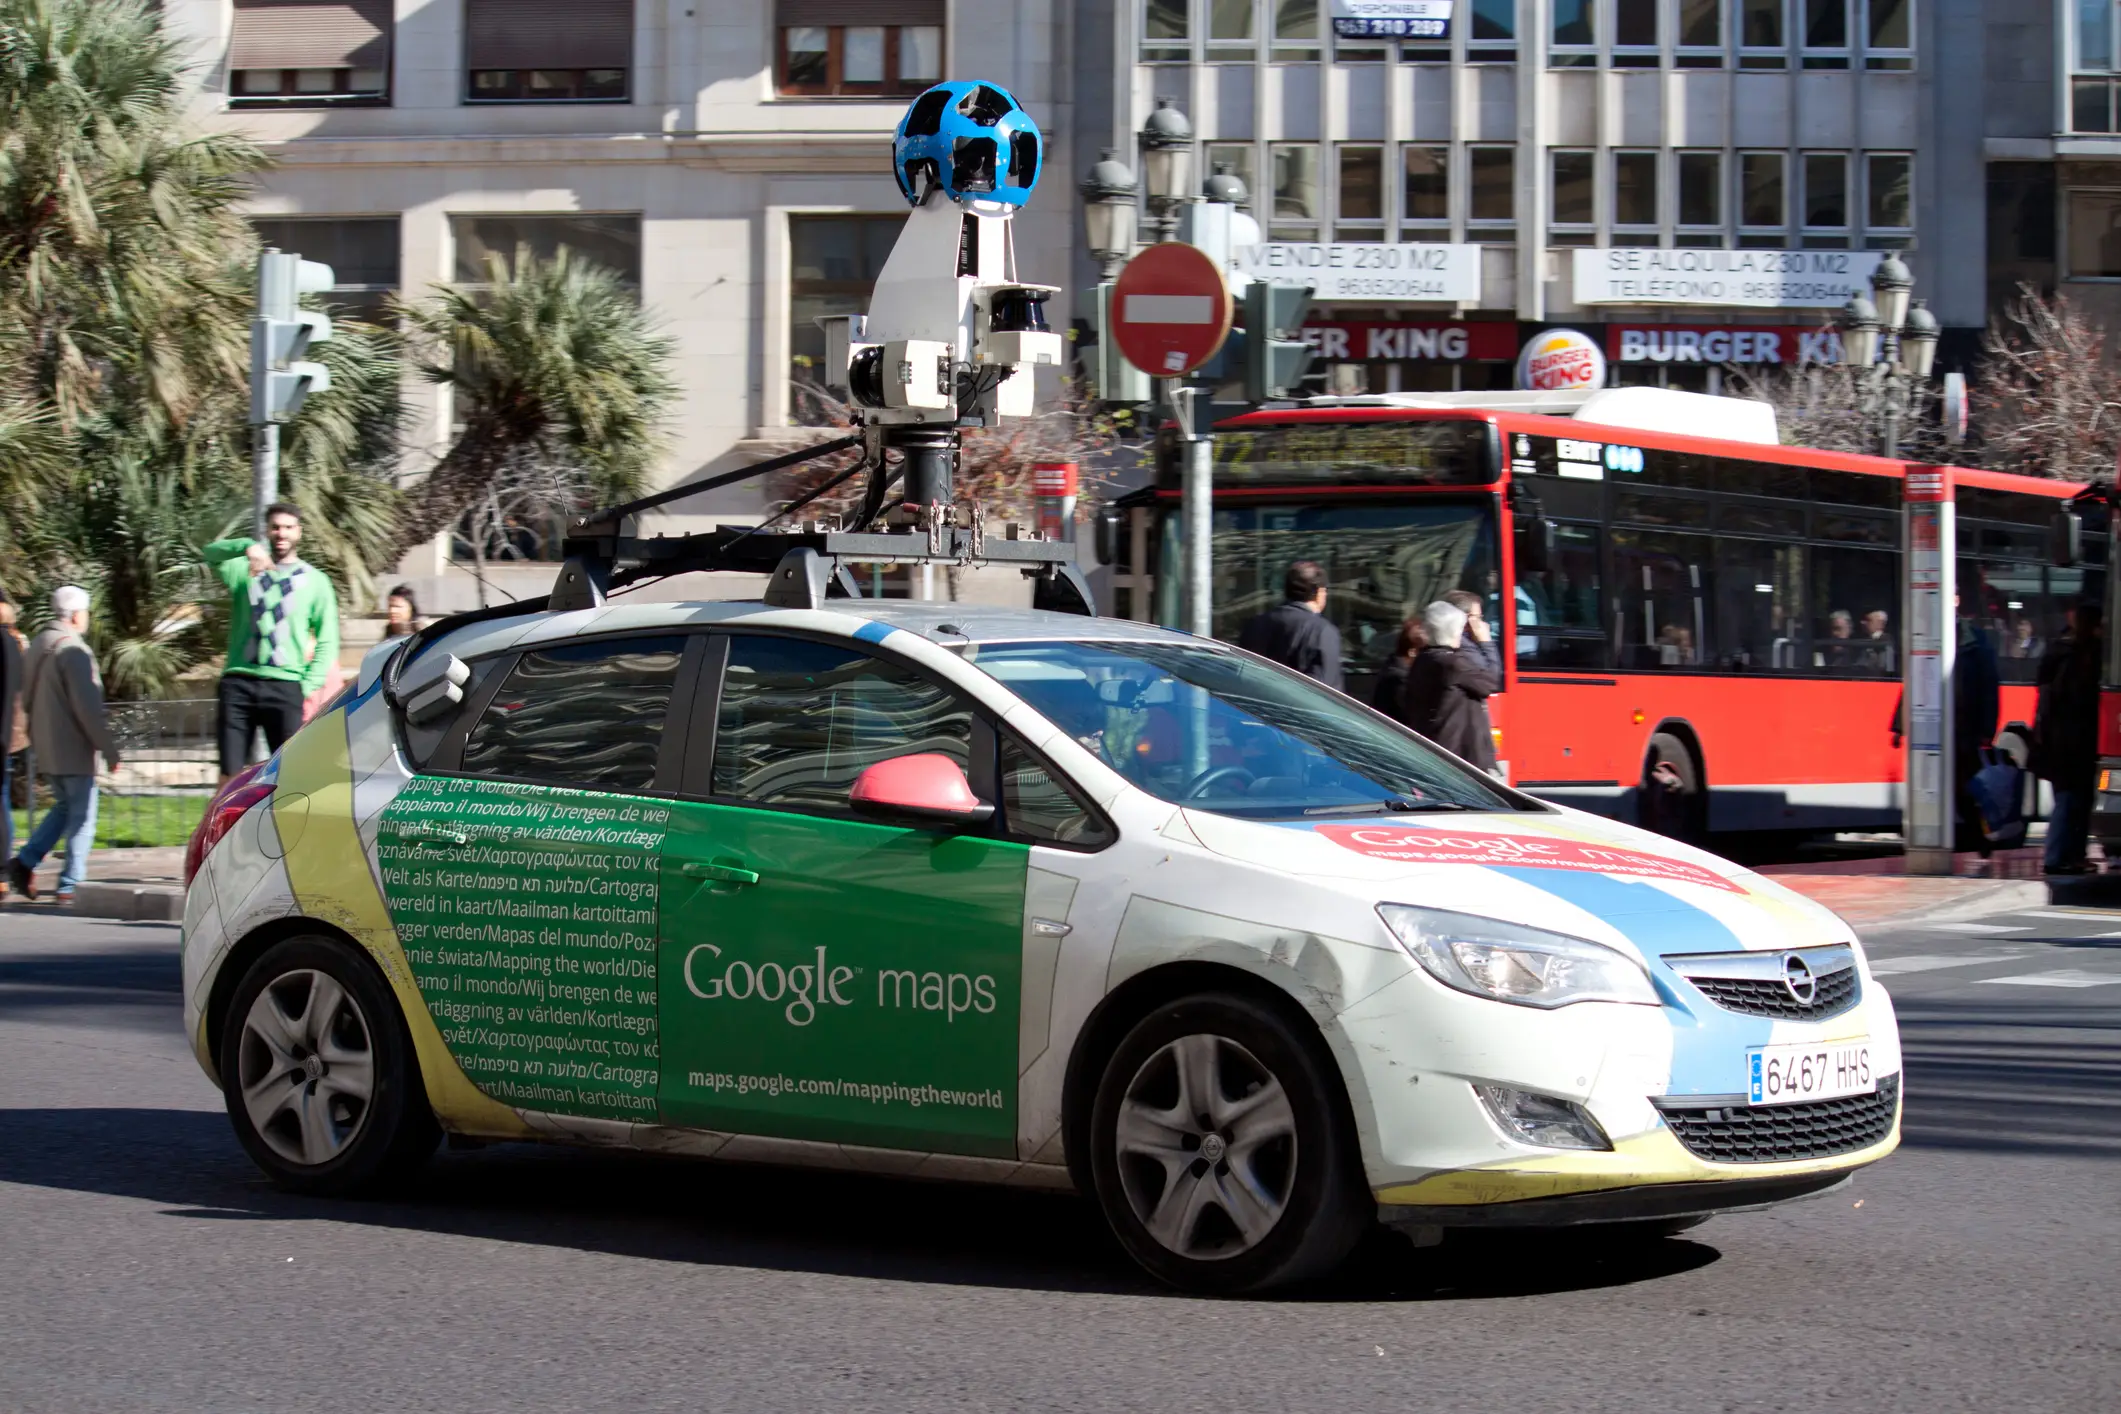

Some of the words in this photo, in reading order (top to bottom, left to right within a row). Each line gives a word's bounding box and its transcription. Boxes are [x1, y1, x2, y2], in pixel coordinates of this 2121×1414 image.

[1247, 245, 1344, 268] VENDE
[1352, 247, 1401, 269] 230
[1408, 249, 1448, 271] M2
[1608, 251, 1641, 271] SE
[1647, 252, 1756, 273] ALQUILA
[1762, 253, 1807, 274] 230
[1812, 254, 1849, 274] M2
[1338, 278, 1444, 296] 963520644
[1741, 282, 1849, 299] 963520644
[1367, 327, 1469, 359] KING
[1621, 330, 1782, 362] BURGER
[1530, 348, 1591, 374] BURGER
[1533, 362, 1593, 390] KING
[449, 779, 472, 792] the
[456, 799, 468, 813] il
[467, 801, 551, 821] mondo/Wij
[552, 803, 616, 824] brengen
[620, 805, 640, 821] de
[513, 825, 533, 839] av
[1351, 830, 1560, 858] Google
[1578, 848, 1711, 878] maps
[413, 868, 432, 886] als
[440, 896, 451, 913] in
[456, 896, 568, 919] kaart/Maailman
[433, 922, 535, 948] verden/Mapas
[539, 927, 560, 945] del
[437, 947, 551, 976] świata/Mapping
[555, 954, 579, 973] the
[583, 958, 656, 978] world/Die
[453, 974, 461, 991] il
[466, 976, 545, 1002] mondo/Wij
[549, 980, 609, 1005] brengen
[614, 985, 633, 1003] de
[683, 943, 854, 1026] Google
[878, 969, 996, 1022] maps
[508, 1007, 523, 1020] av
[1753, 1083, 1761, 1095] E
[1767, 1053, 1828, 1096] 6467
[1836, 1048, 1870, 1089] HHS
[689, 1071, 1003, 1109] maps.google.com/mappingtheworld
